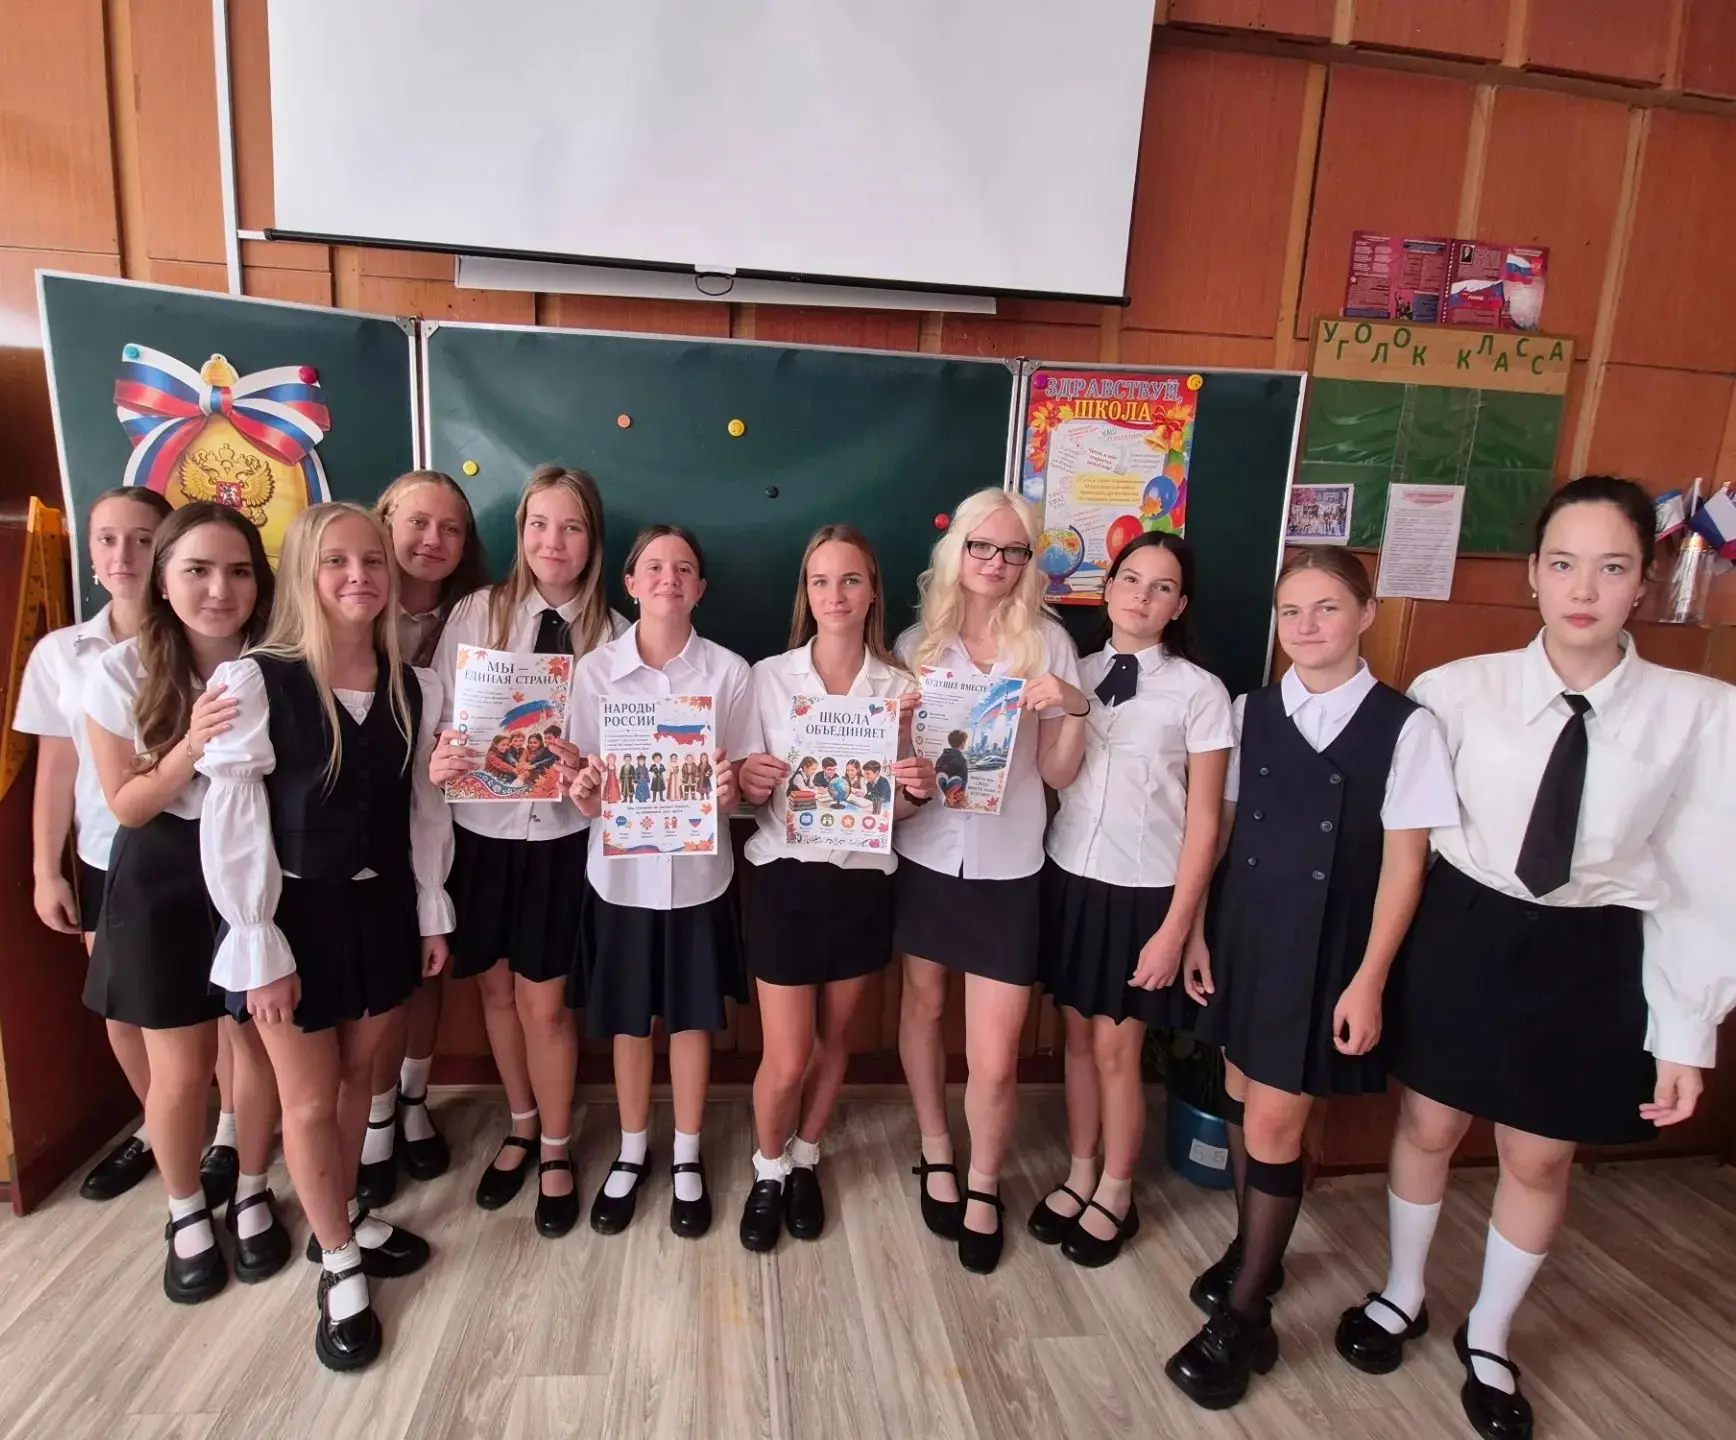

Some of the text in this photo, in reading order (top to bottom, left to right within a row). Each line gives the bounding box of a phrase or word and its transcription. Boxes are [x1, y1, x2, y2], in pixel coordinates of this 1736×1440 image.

[1323, 322, 1564, 375] УГОЛОК КЛАССА
[1045, 377, 1183, 404] ЗДРАВСТВУЙ,
[1074, 399, 1152, 421] ШКОЛА
[487, 661, 514, 674] МЫ
[464, 669, 558, 685] ЕДИНАЯ СТРАНА
[960, 683, 989, 692] ВМЕСТЕ
[604, 703, 656, 715] НАРОДЫ
[604, 715, 655, 727] РОССИИ
[819, 711, 870, 726] ШКОЛА
[805, 724, 887, 739] ОБЪЕДИНЯЕТ
